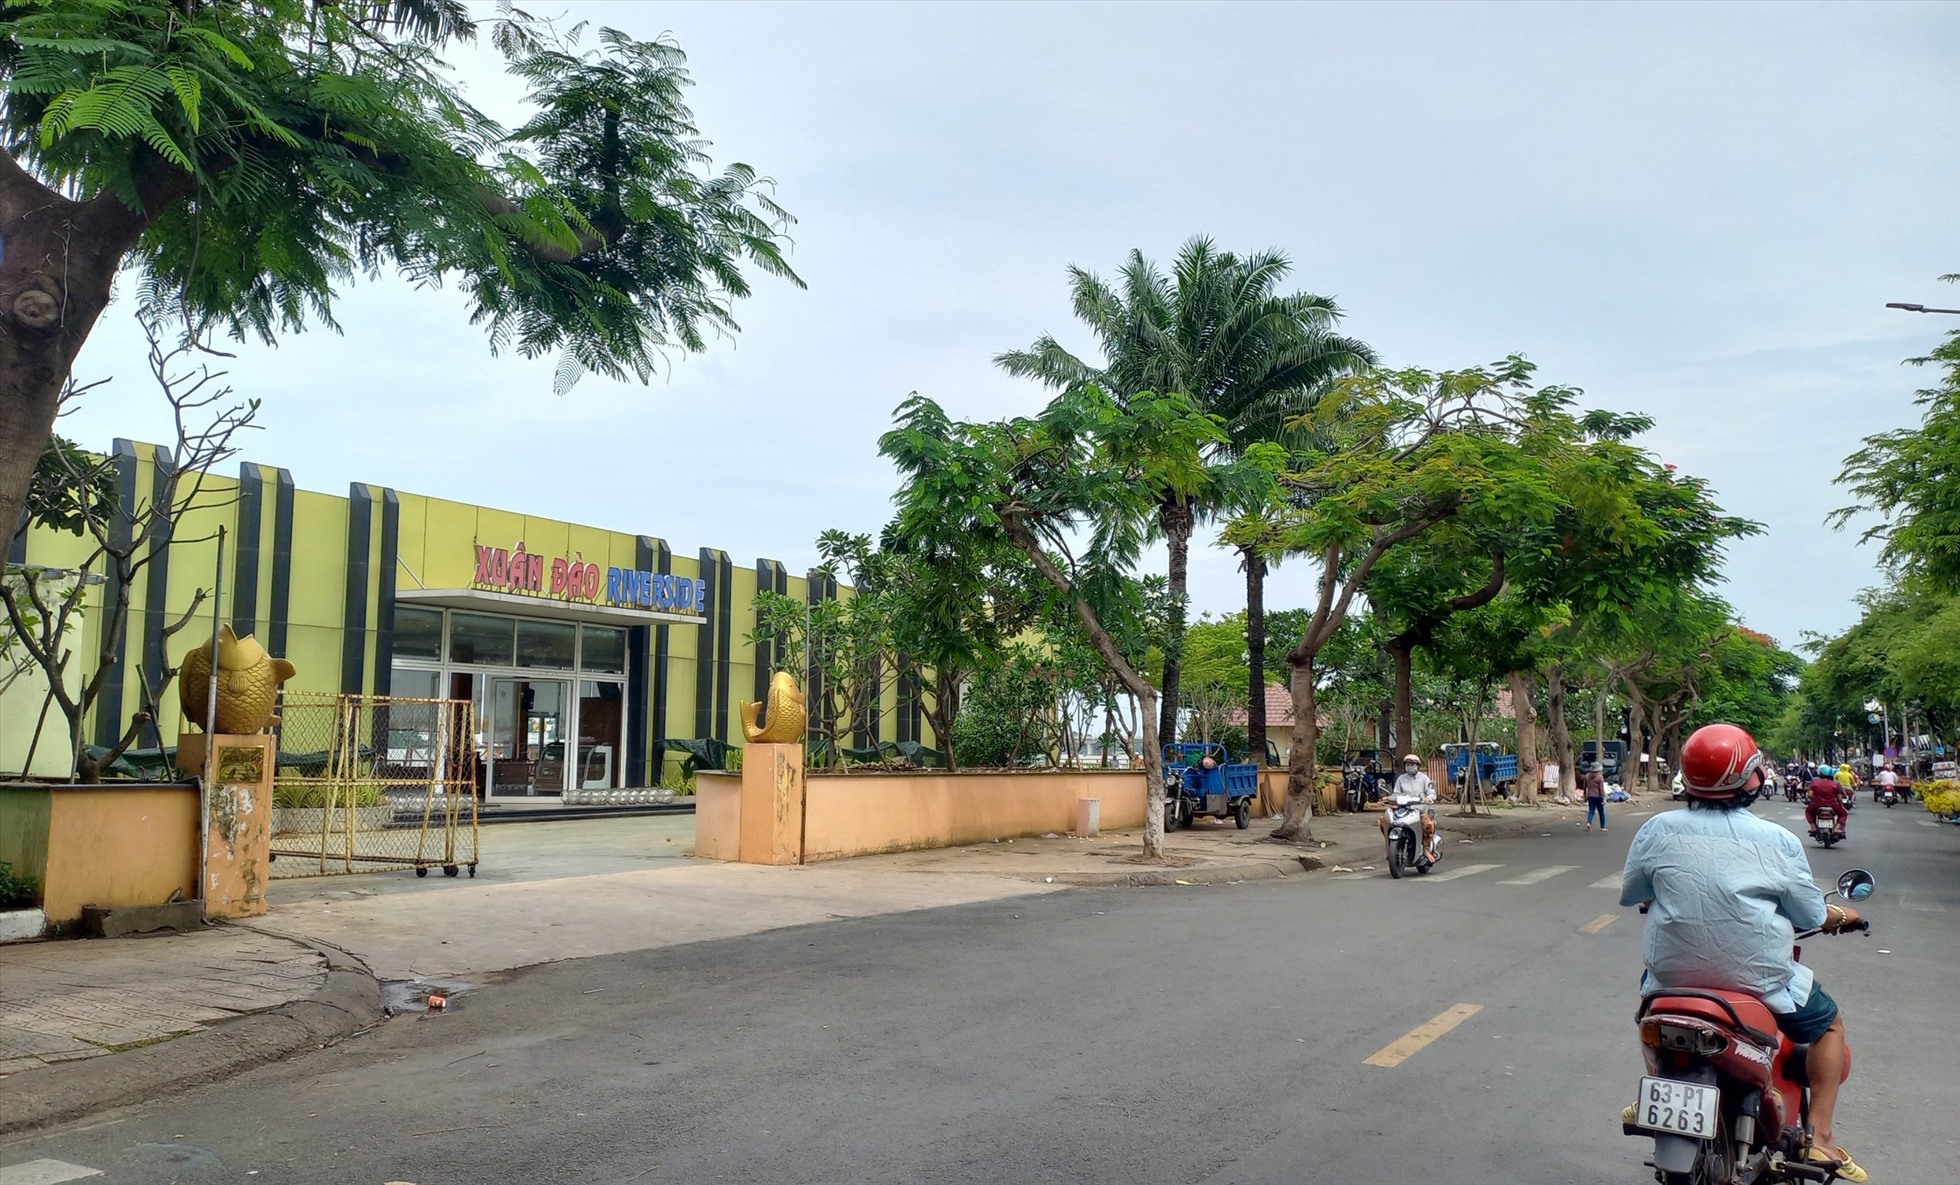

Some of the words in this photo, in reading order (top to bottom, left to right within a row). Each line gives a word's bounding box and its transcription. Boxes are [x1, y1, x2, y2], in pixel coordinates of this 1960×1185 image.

[474, 541, 543, 592] XUÂN
[551, 551, 600, 600] ĐÀO
[606, 567, 706, 612] RIVERSIDE
[1650, 1081, 1704, 1110] 63-P1
[1647, 1104, 1704, 1133] 6263
